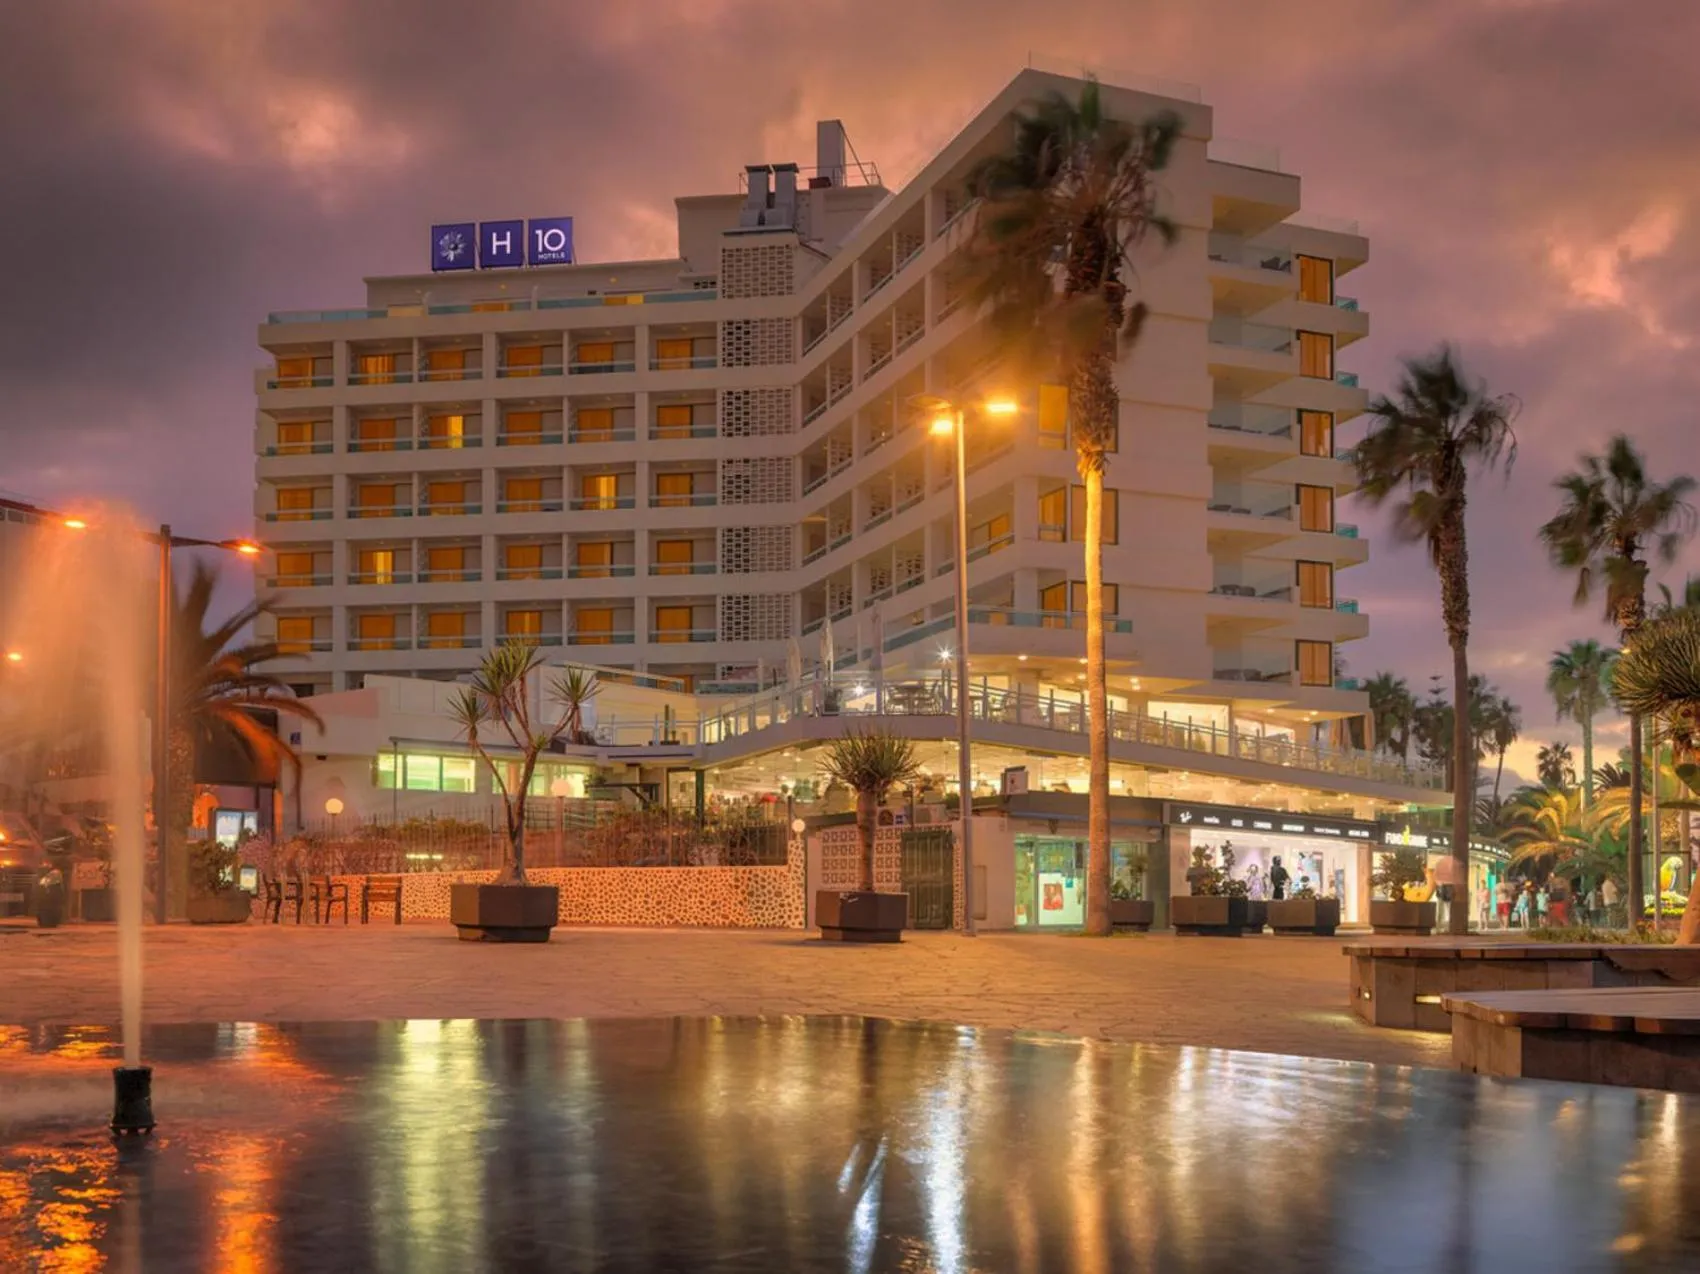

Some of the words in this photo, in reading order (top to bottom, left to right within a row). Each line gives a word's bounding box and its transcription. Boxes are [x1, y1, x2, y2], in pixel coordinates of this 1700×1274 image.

[492, 231, 511, 255] H
[535, 229, 566, 252] 10
[538, 252, 565, 260] HOTELS
